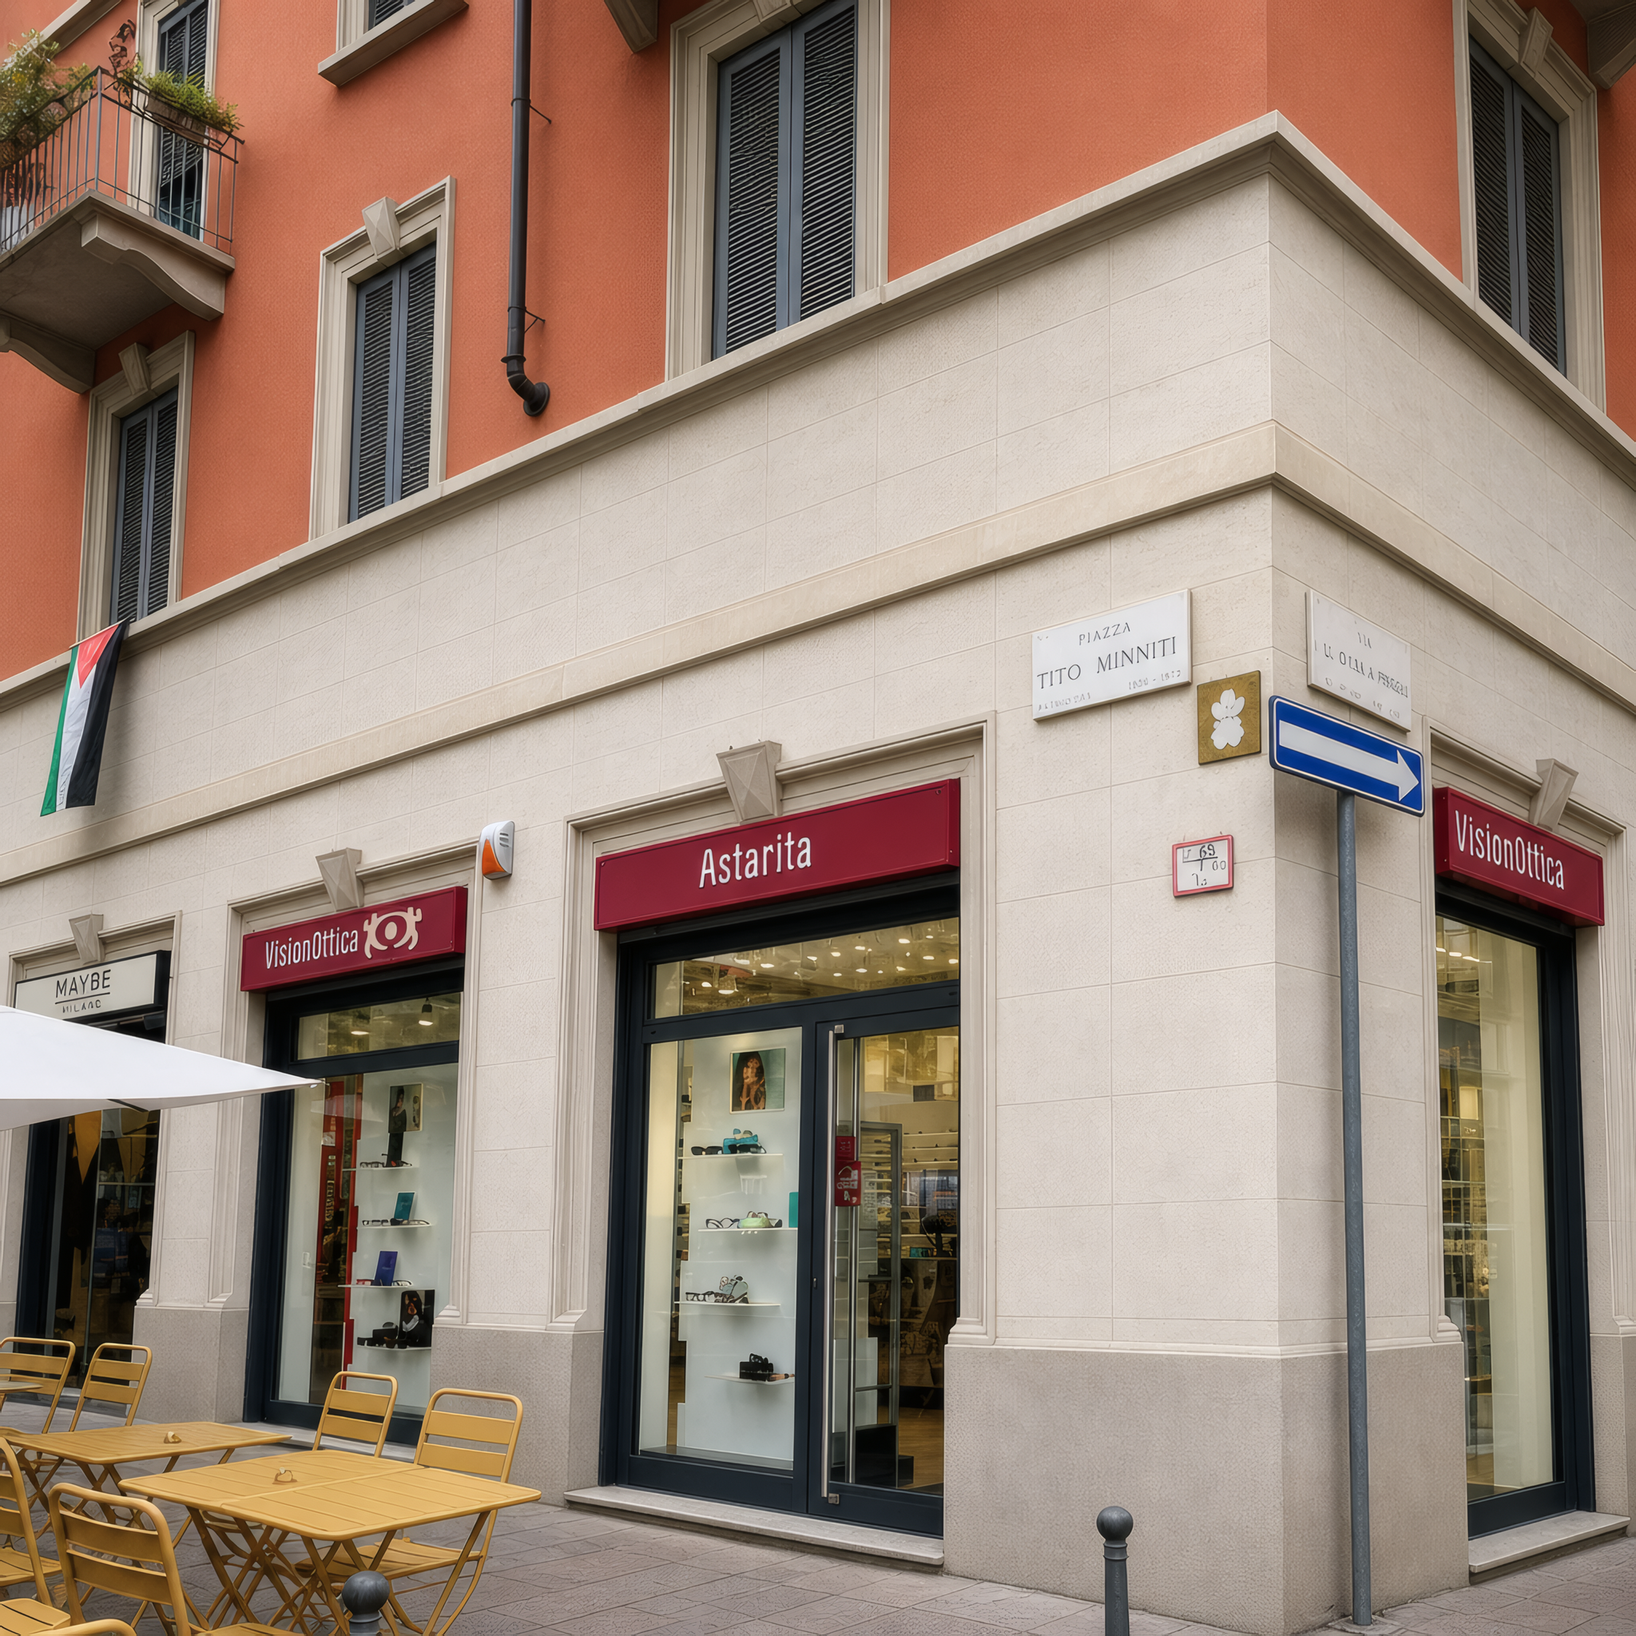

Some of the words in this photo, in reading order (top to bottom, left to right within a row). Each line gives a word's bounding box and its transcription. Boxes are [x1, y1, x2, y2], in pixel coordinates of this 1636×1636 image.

[1078, 621, 1132, 646] PIAZZA
[1036, 663, 1082, 690] TITO
[1096, 636, 1176, 674] MINNITI
[698, 831, 812, 889] Astarita
[1455, 809, 1565, 890] VisionOttica
[265, 927, 358, 970] VisionOttica
[55, 969, 111, 998] MAYBE
